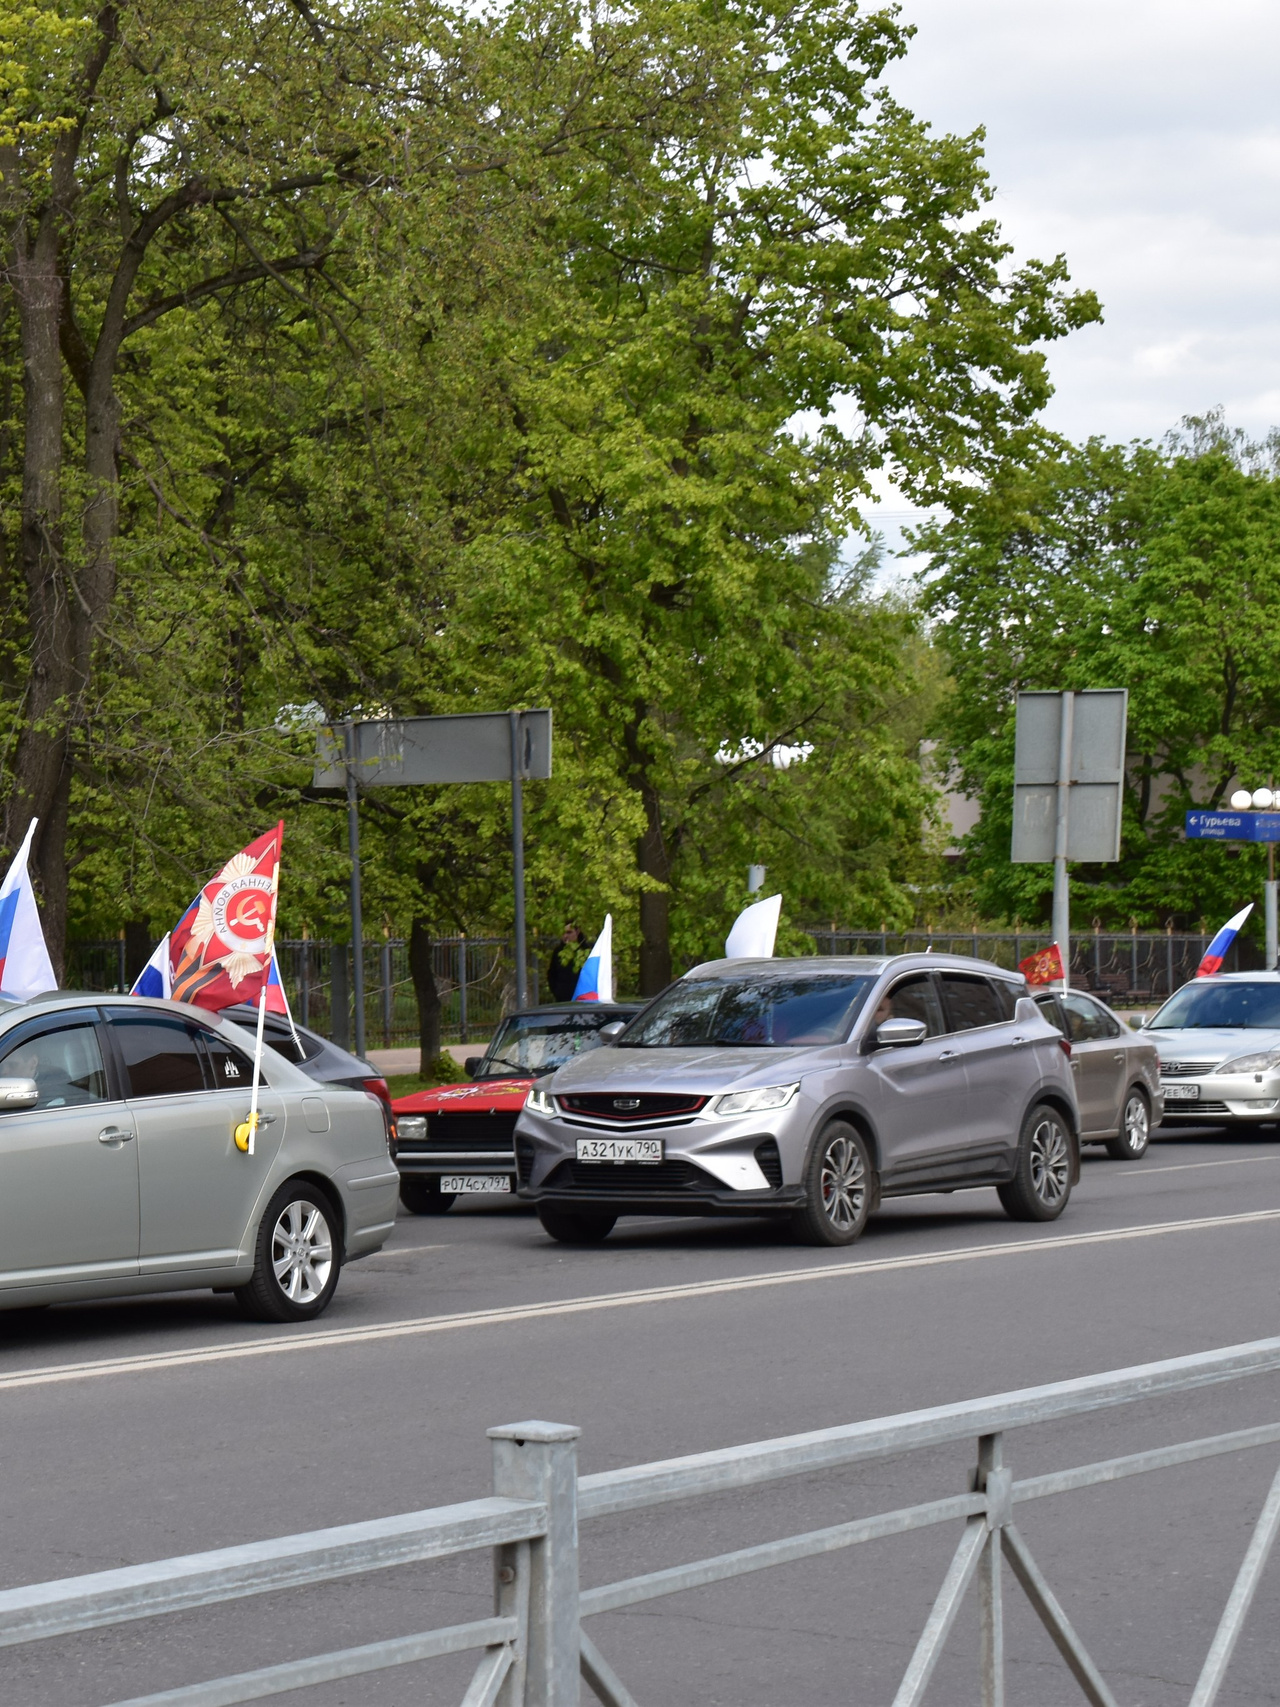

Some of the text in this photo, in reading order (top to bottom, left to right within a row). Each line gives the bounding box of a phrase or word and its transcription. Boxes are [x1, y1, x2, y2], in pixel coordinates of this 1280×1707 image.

[1200, 815, 1241, 828] Гурьева
[581, 1141, 658, 1158] А321УК 790
[443, 1176, 506, 1191] Р074СХ 797
